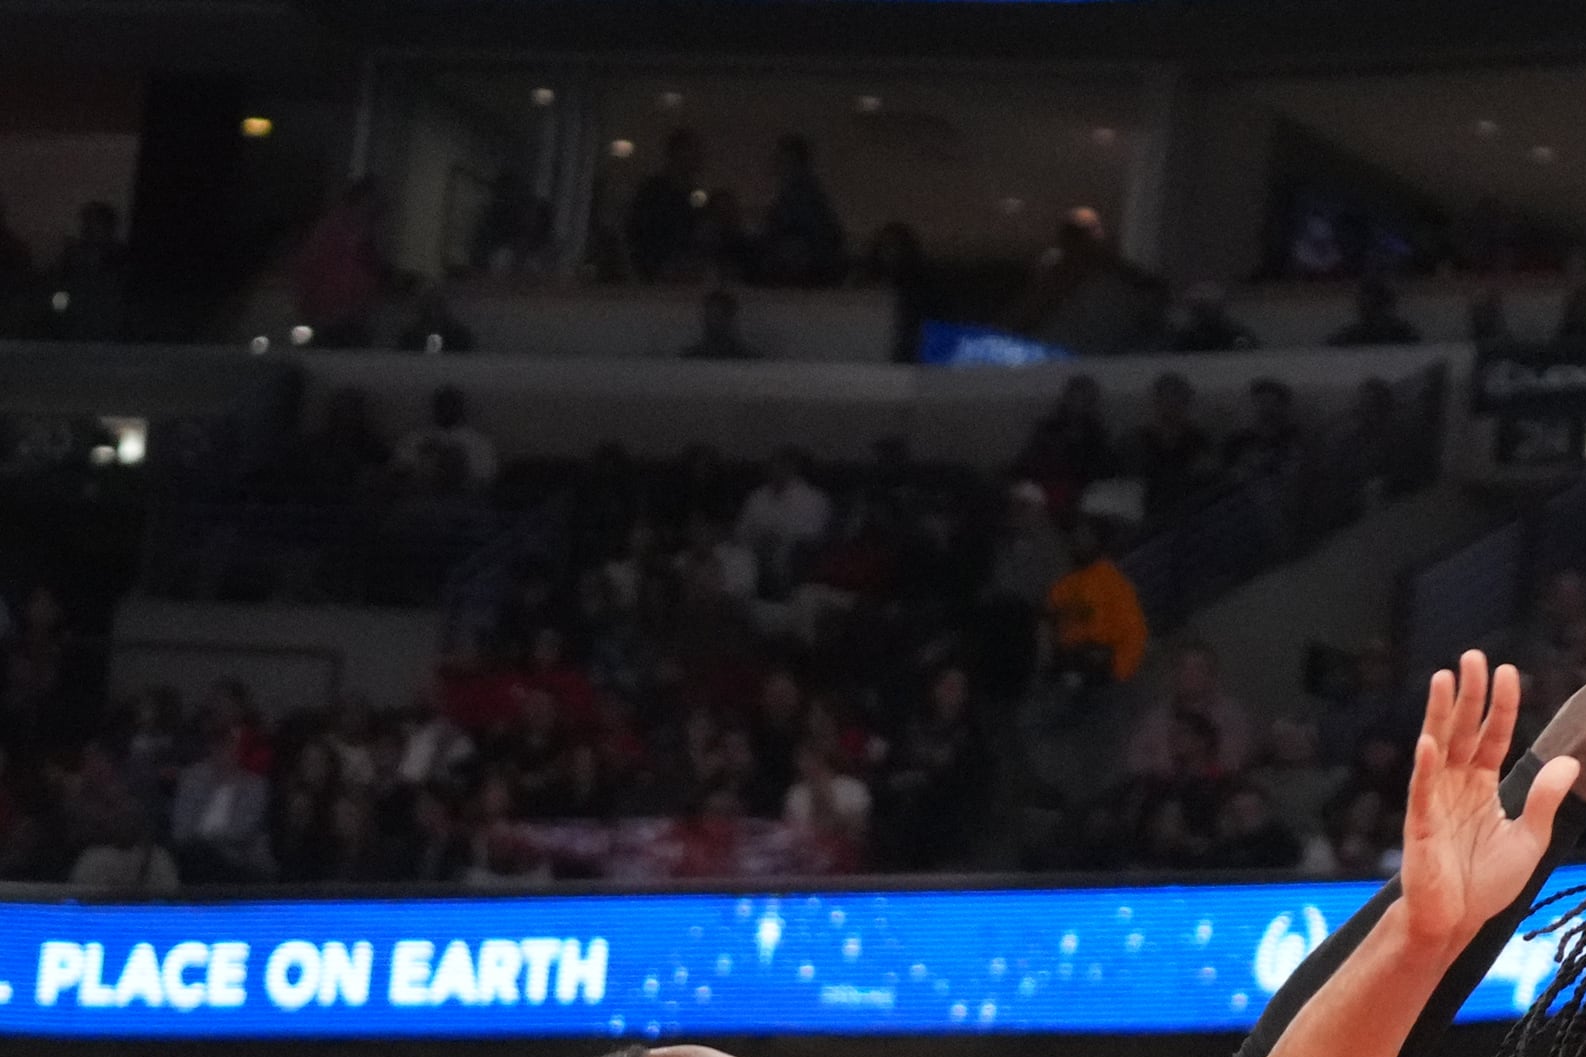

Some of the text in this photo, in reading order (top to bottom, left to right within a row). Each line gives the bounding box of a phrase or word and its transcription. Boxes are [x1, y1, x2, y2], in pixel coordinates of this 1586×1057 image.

[34, 938, 608, 1008] PLACE ON EARTH
